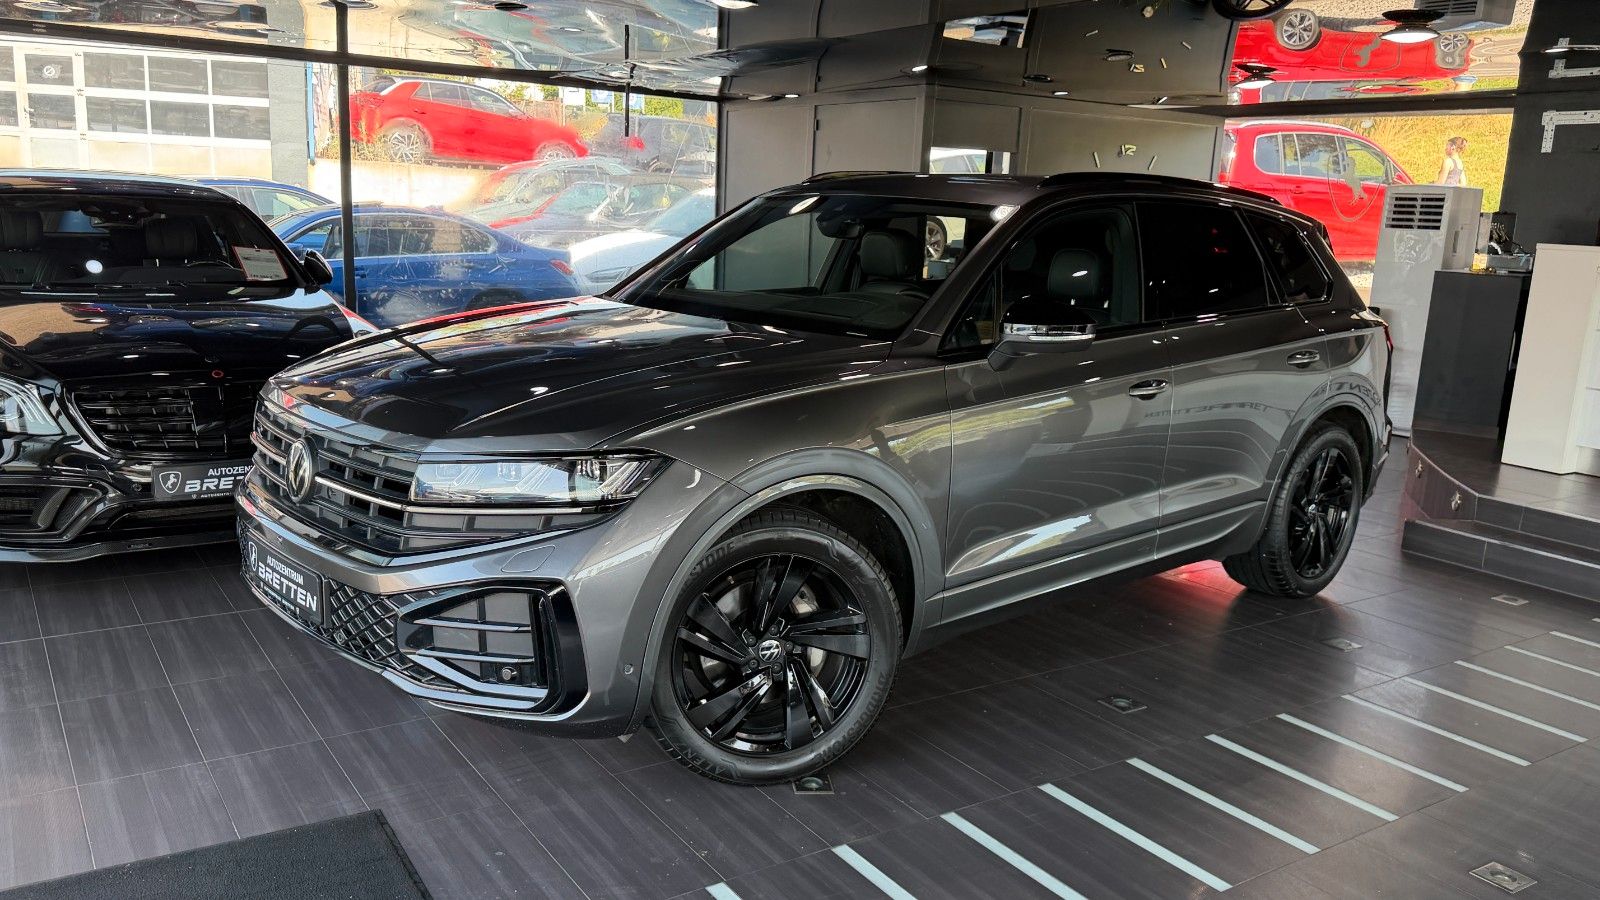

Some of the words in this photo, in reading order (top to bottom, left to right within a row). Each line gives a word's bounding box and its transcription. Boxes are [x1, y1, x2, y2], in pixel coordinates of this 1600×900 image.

[207, 465, 253, 477] AUTOZEN
[266, 555, 304, 586] AUTOZENTRUM
[258, 561, 317, 612] BRETTEN
